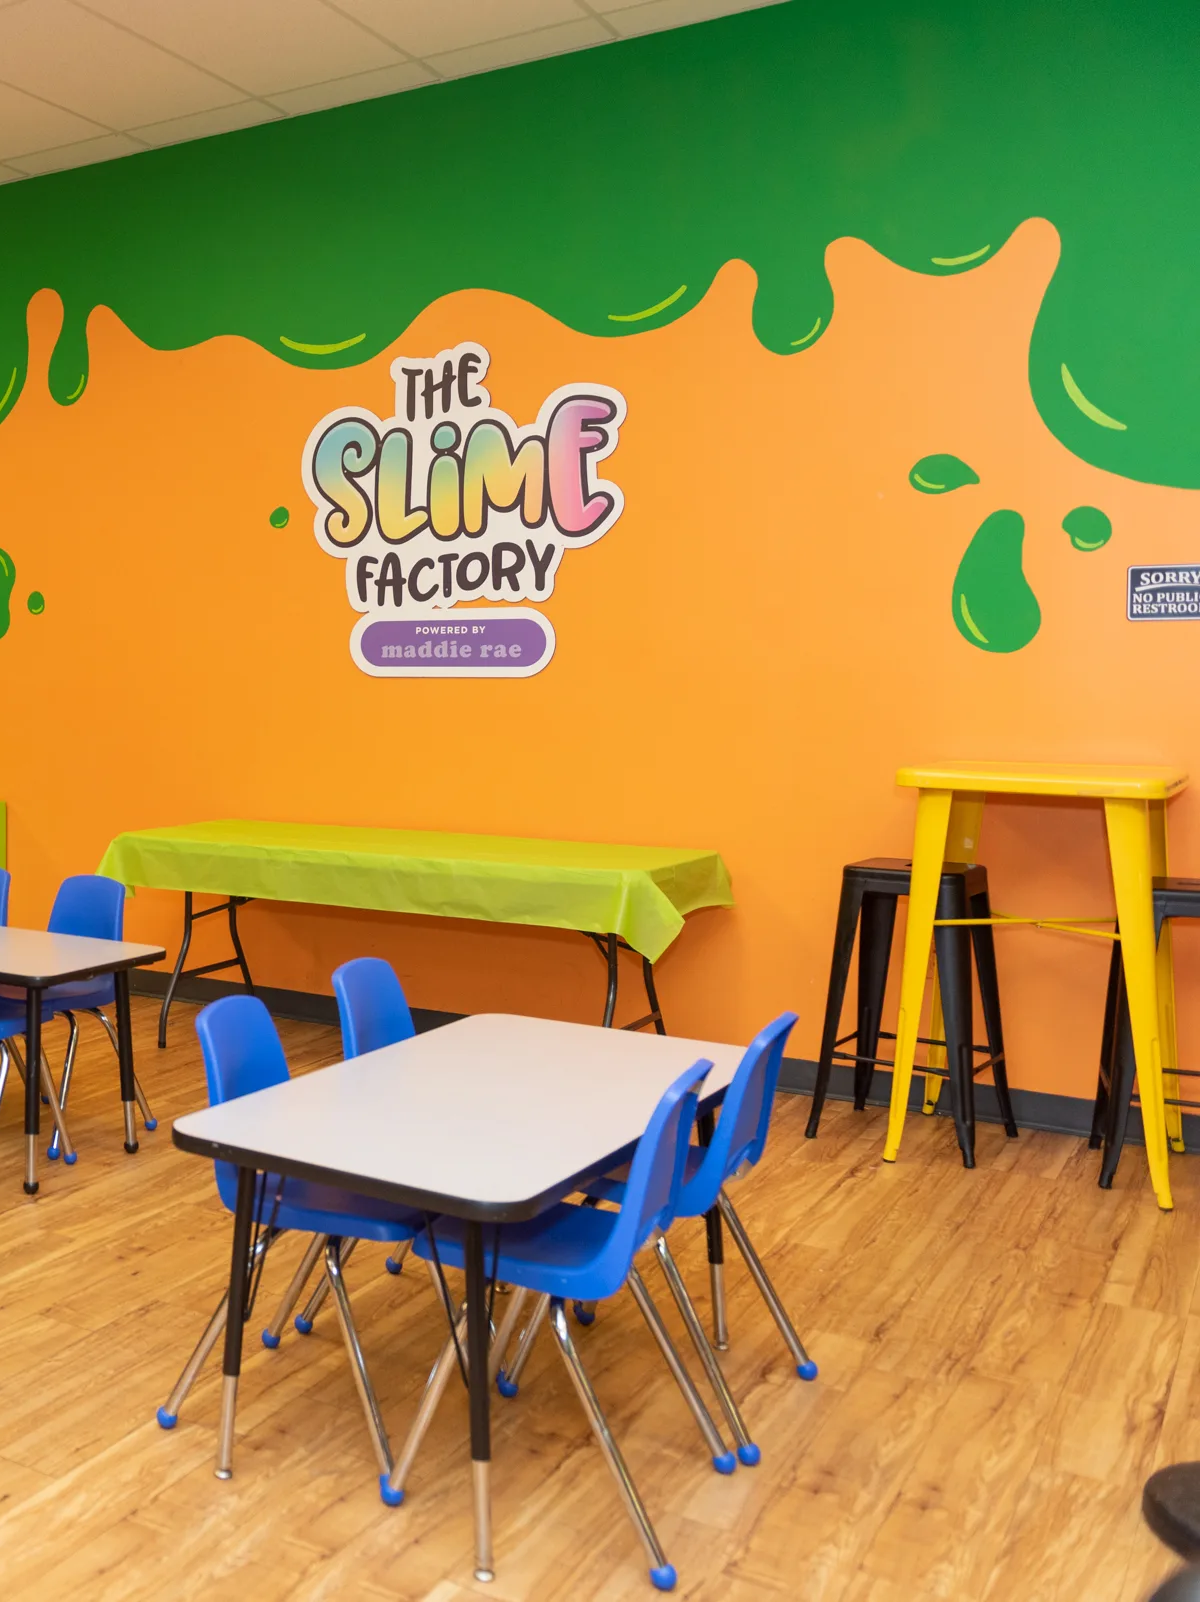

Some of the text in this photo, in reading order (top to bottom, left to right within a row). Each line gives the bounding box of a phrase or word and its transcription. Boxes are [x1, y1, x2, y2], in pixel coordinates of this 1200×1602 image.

[401, 353, 482, 422] THE
[356, 539, 556, 607] FACTORY
[1140, 571, 1200, 586] SORRY
[1132, 592, 1200, 603] NO PUBLI
[1132, 603, 1200, 614] RESTROO
[415, 626, 486, 635] POWERED BY
[381, 640, 522, 659] maddie rae
